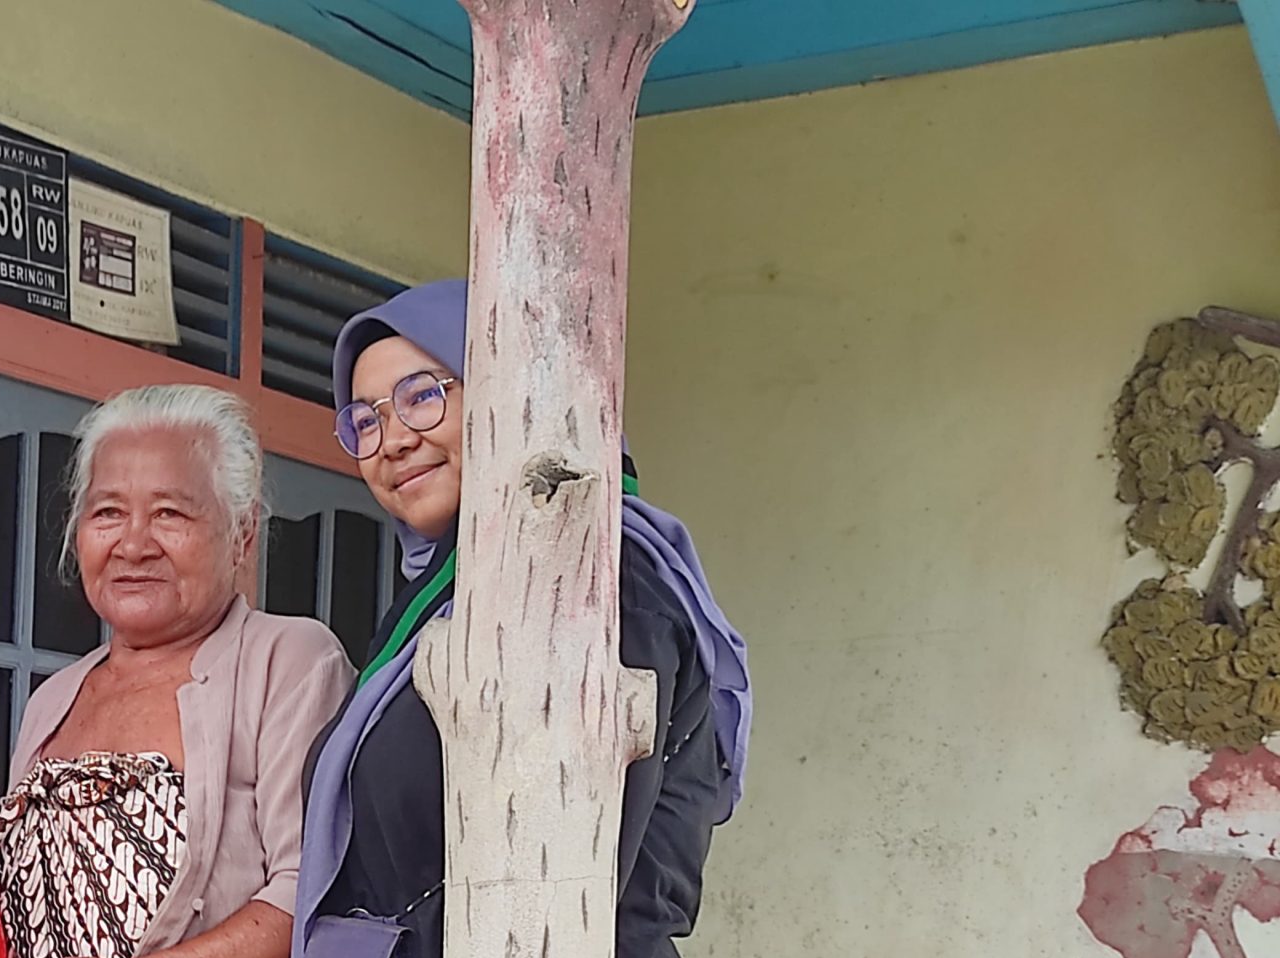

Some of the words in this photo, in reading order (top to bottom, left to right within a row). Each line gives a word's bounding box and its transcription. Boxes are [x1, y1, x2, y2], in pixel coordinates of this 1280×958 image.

[32, 184, 61, 204] RW
[36, 215, 57, 253] 09
[0, 261, 55, 290] BERINGIN
